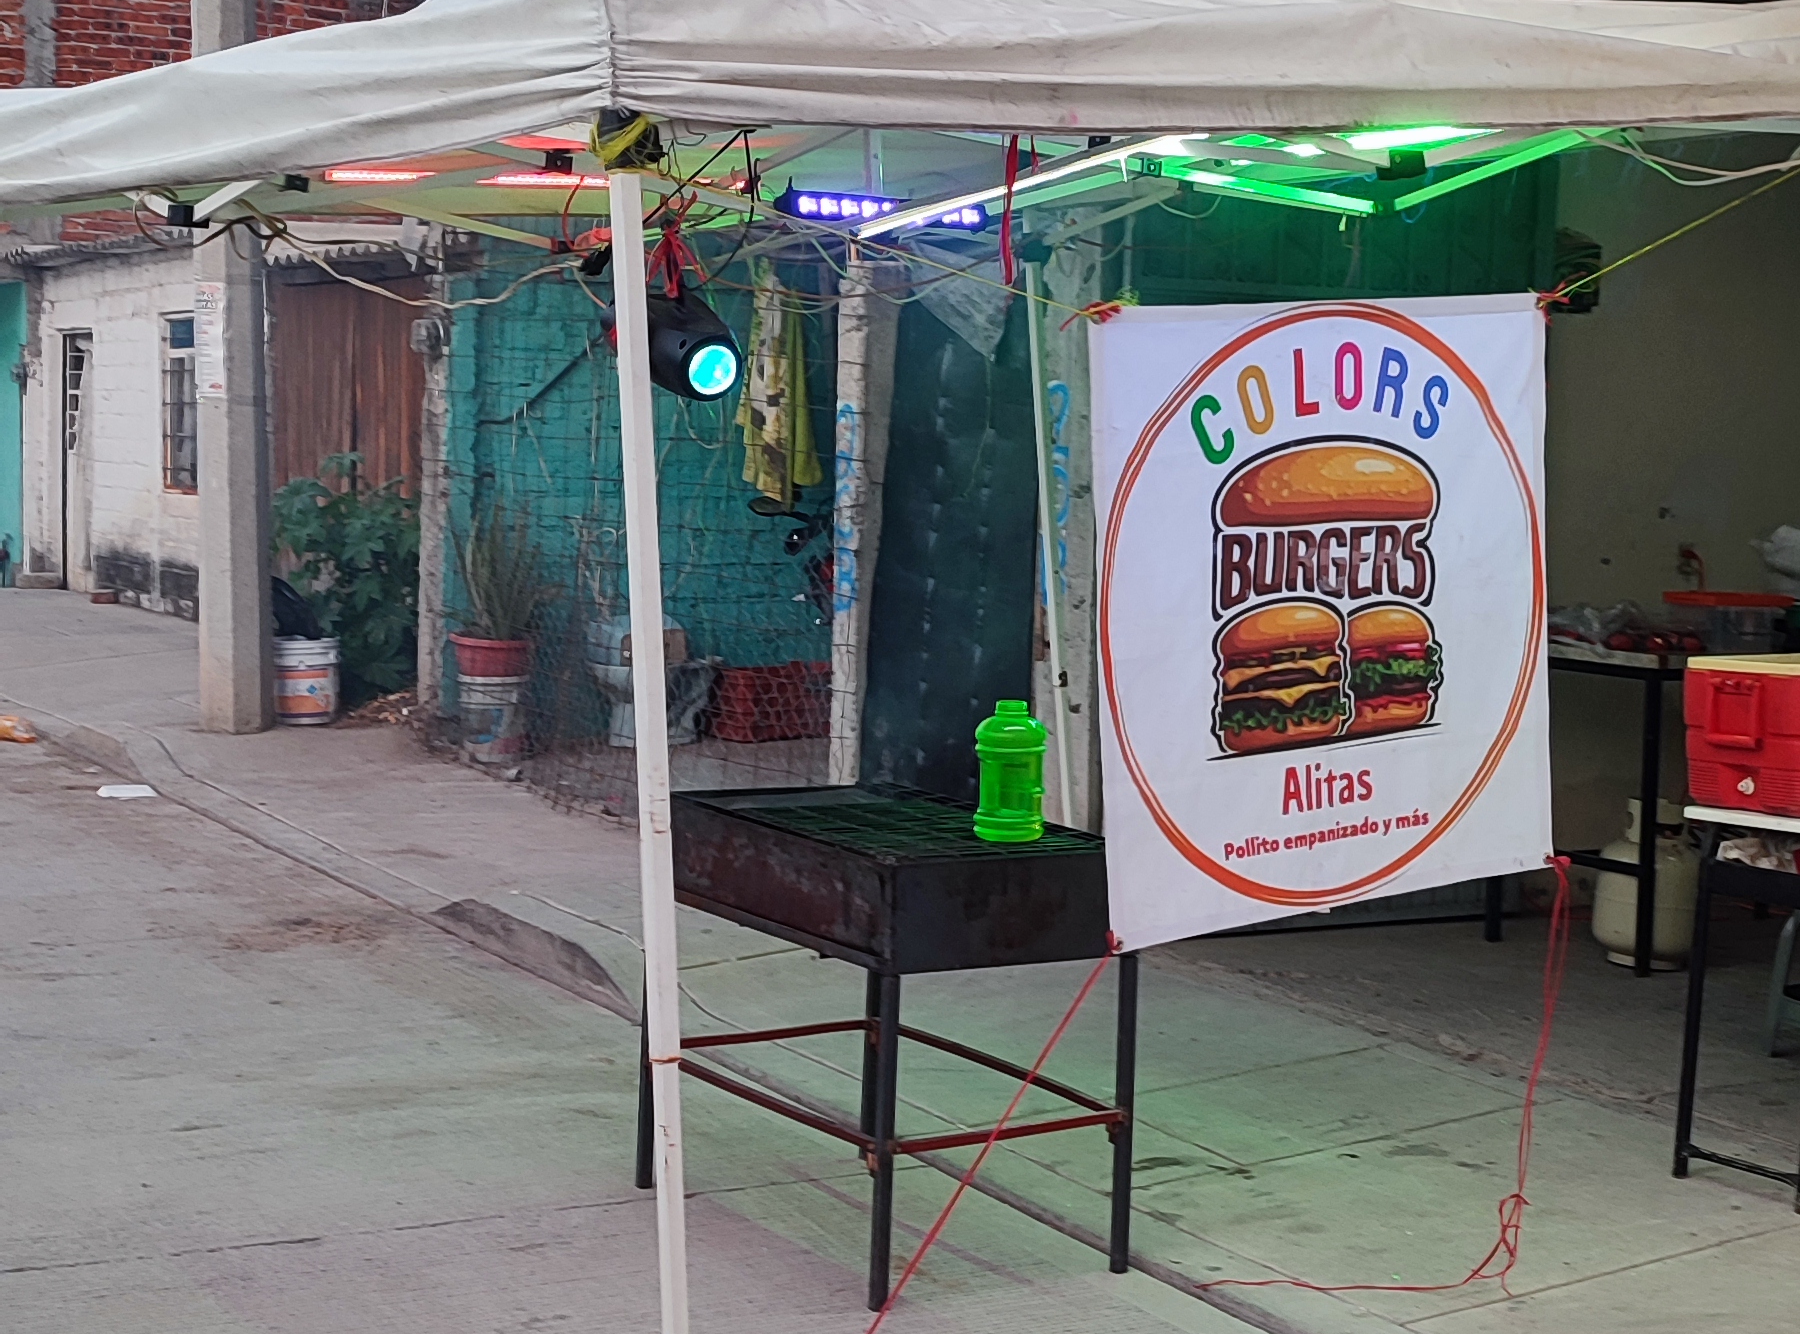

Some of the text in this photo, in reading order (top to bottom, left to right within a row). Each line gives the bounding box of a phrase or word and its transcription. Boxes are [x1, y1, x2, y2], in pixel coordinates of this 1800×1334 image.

[1189, 340, 1450, 465] COLORS
[1219, 522, 1427, 611] BURGERS
[1281, 762, 1374, 816] Alitas
[1223, 808, 1430, 861] Pollito empanizado y más
